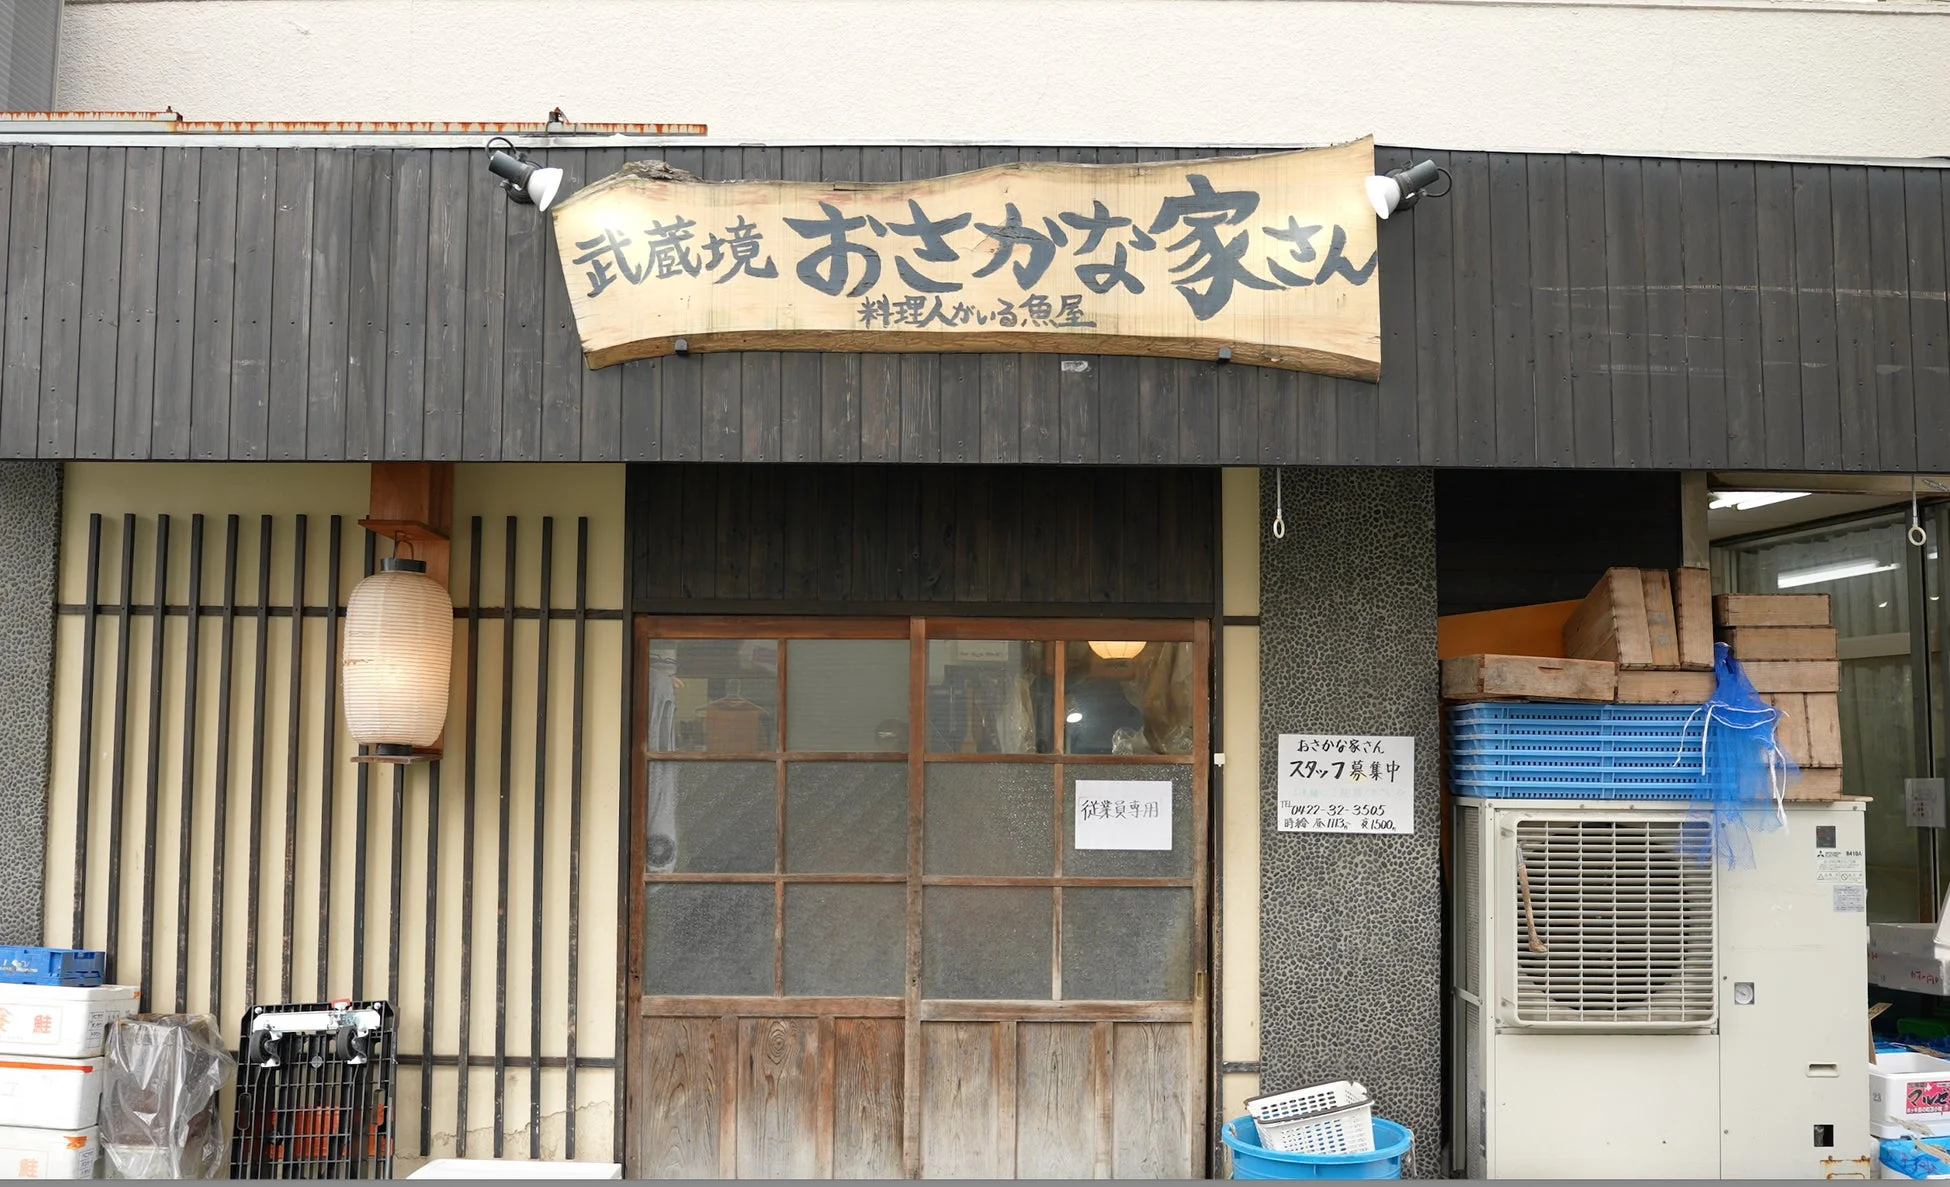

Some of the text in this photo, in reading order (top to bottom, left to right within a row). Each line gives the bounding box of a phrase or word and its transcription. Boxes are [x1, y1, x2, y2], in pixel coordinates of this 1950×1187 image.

[572, 173, 1378, 321] 武蔵境 おさかな家さん
[857, 294, 1097, 328] 料理人がいる魚屋
[1297, 739, 1385, 754] おさかな家さん
[1289, 760, 1400, 782] スタッフ募集中
[1081, 799, 1158, 820] 従業員専用
[1291, 804, 1386, 816] 0422-32-3505
[1284, 817, 1309, 829] 時給
